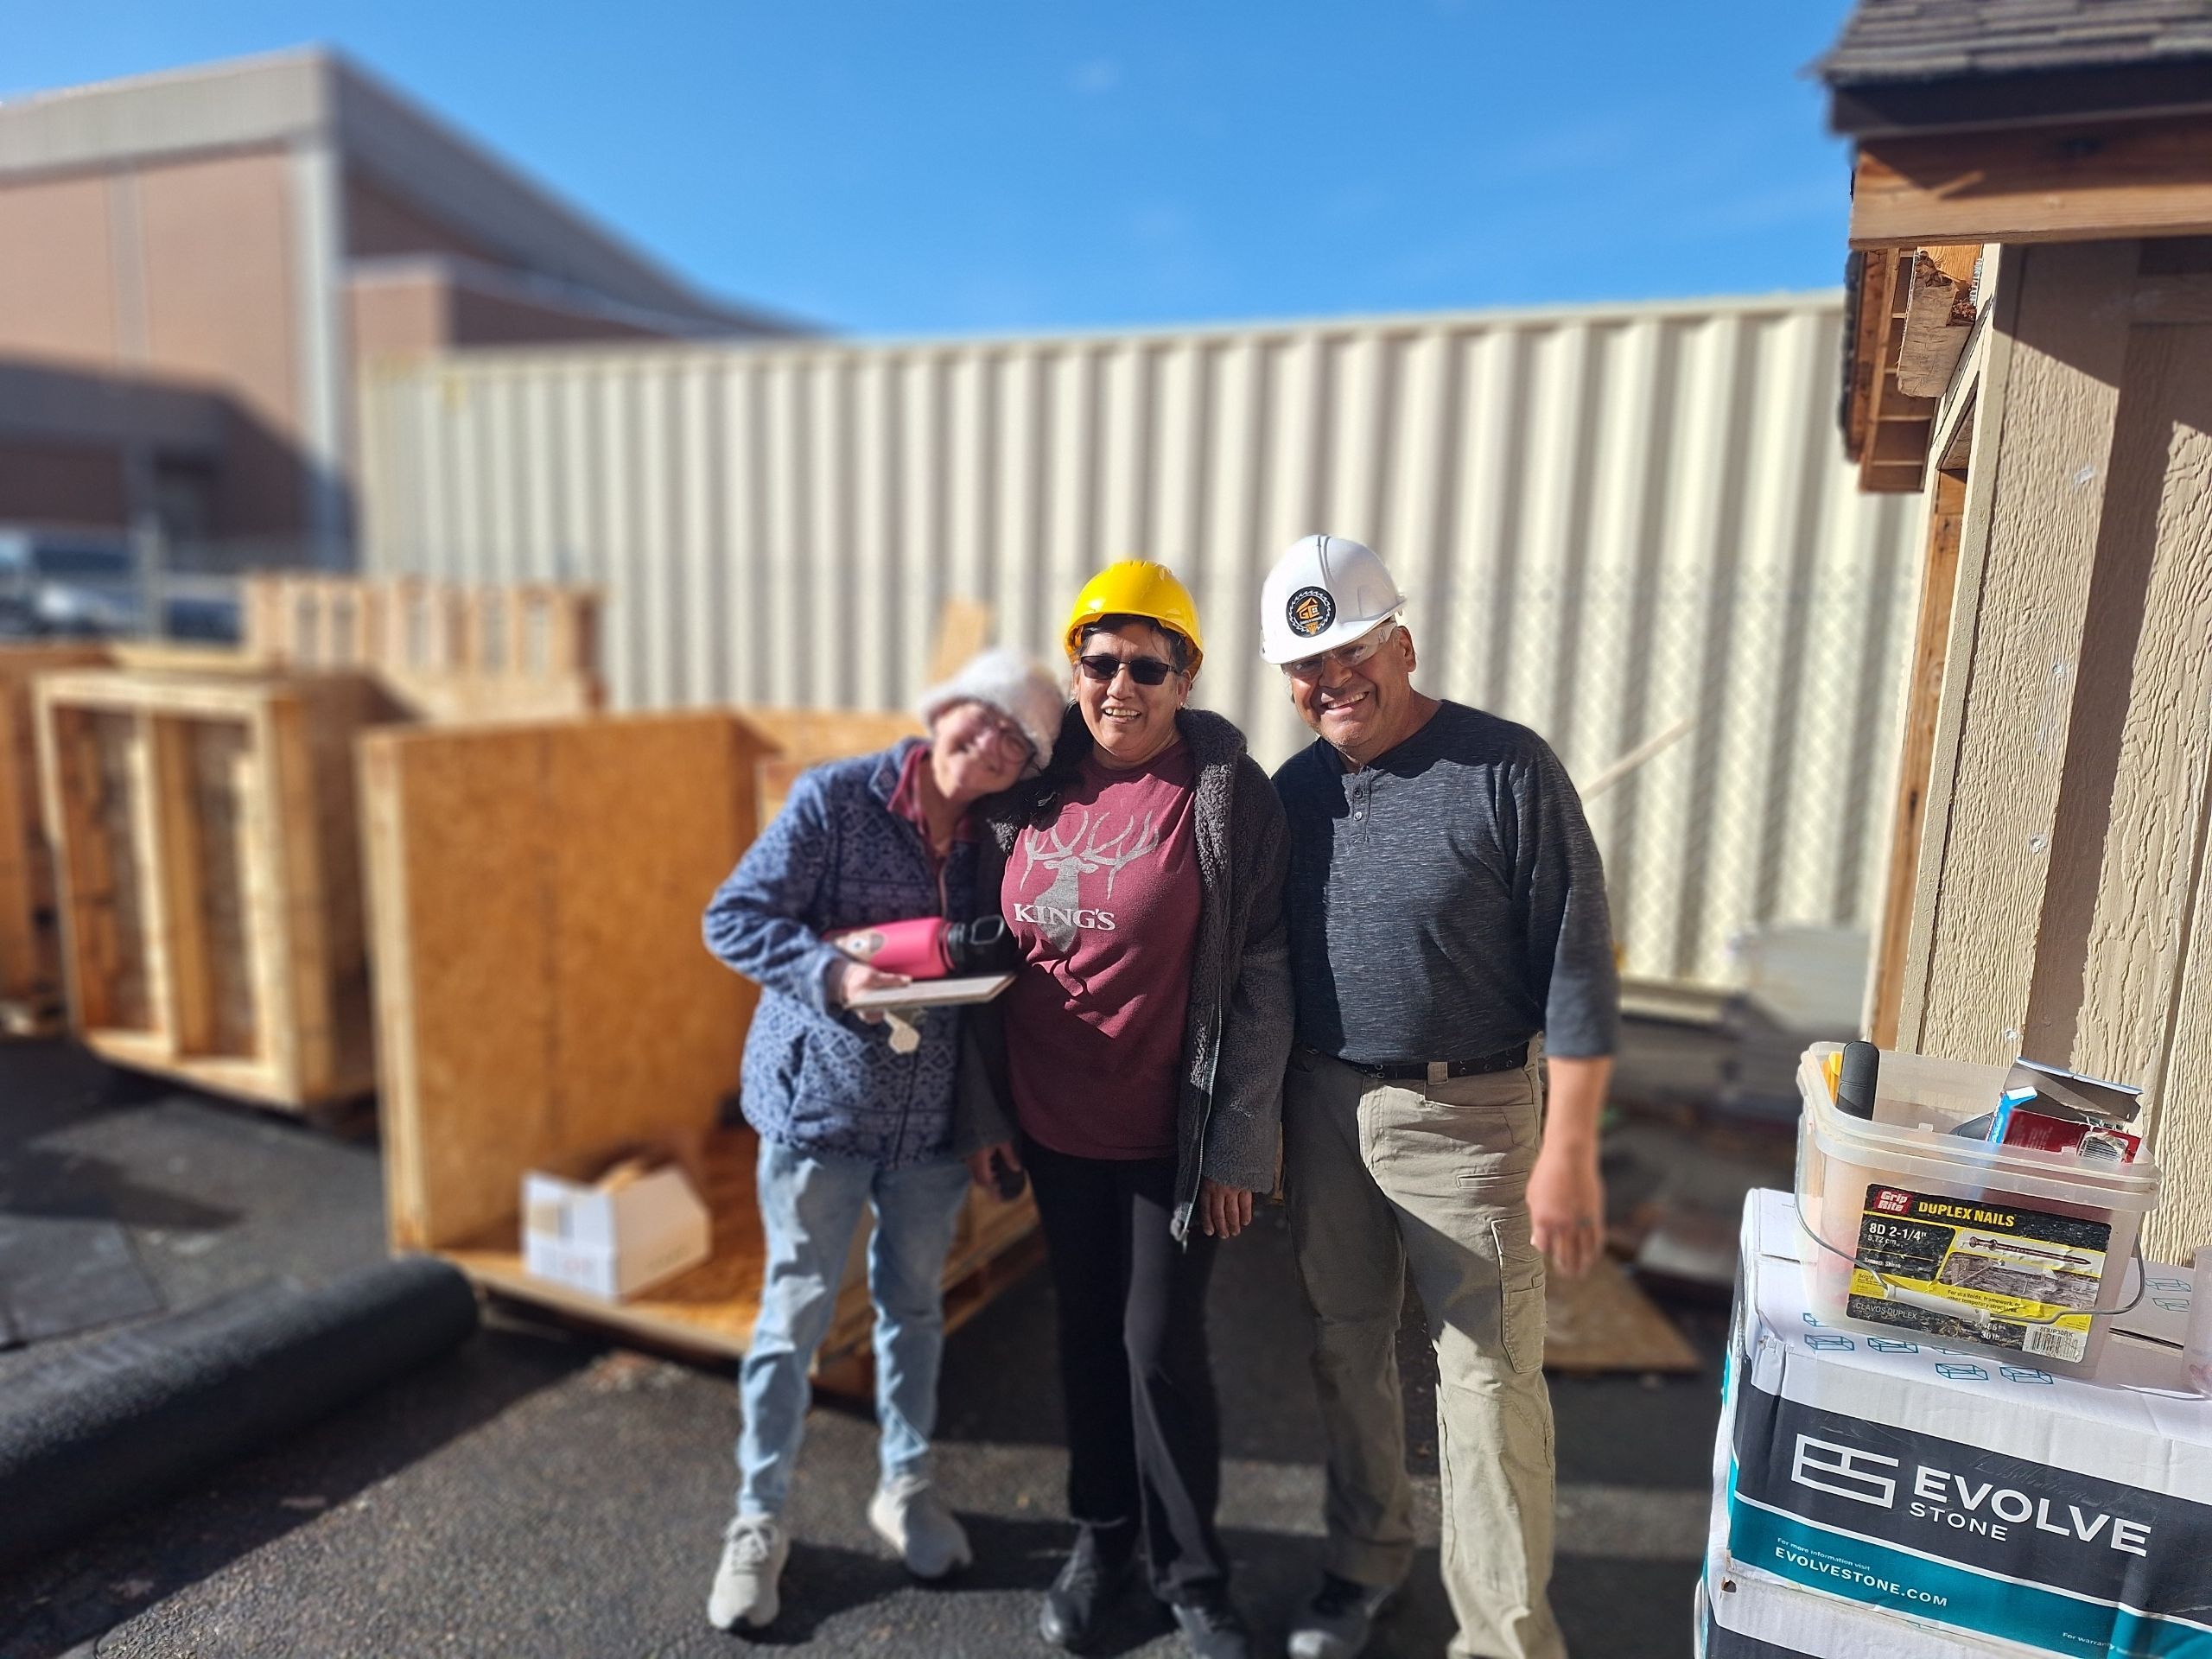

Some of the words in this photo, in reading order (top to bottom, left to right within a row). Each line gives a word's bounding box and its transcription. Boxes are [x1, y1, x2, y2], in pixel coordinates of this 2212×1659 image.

[1013, 903, 1116, 931] KING'S
[1878, 1199, 1904, 1212] Rite
[1880, 1191, 1908, 1204] Grip
[1918, 1201, 1972, 1220] DUPLEX
[1974, 1210, 2015, 1227] NAILS
[1867, 1234, 1884, 1244] 5.72
[1869, 1223, 1885, 1235] 8D
[1888, 1226, 1927, 1242] 2-1/4"
[1855, 1302, 1885, 1314] CLAVOS
[1887, 1306, 1917, 1319] DUPLEX
[1980, 1331, 1992, 1340] 30
[1913, 1465, 2152, 1558] EVOLVE
[1909, 1501, 2010, 1542] STONE
[1777, 1537, 1789, 1546] For
[1790, 1542, 1809, 1554] more
[1810, 1549, 1853, 1566] information
[1854, 1561, 1871, 1572] visit
[1775, 1547, 1948, 1607] EVOLVESTONE.COM
[2062, 1631, 2076, 1640] For
